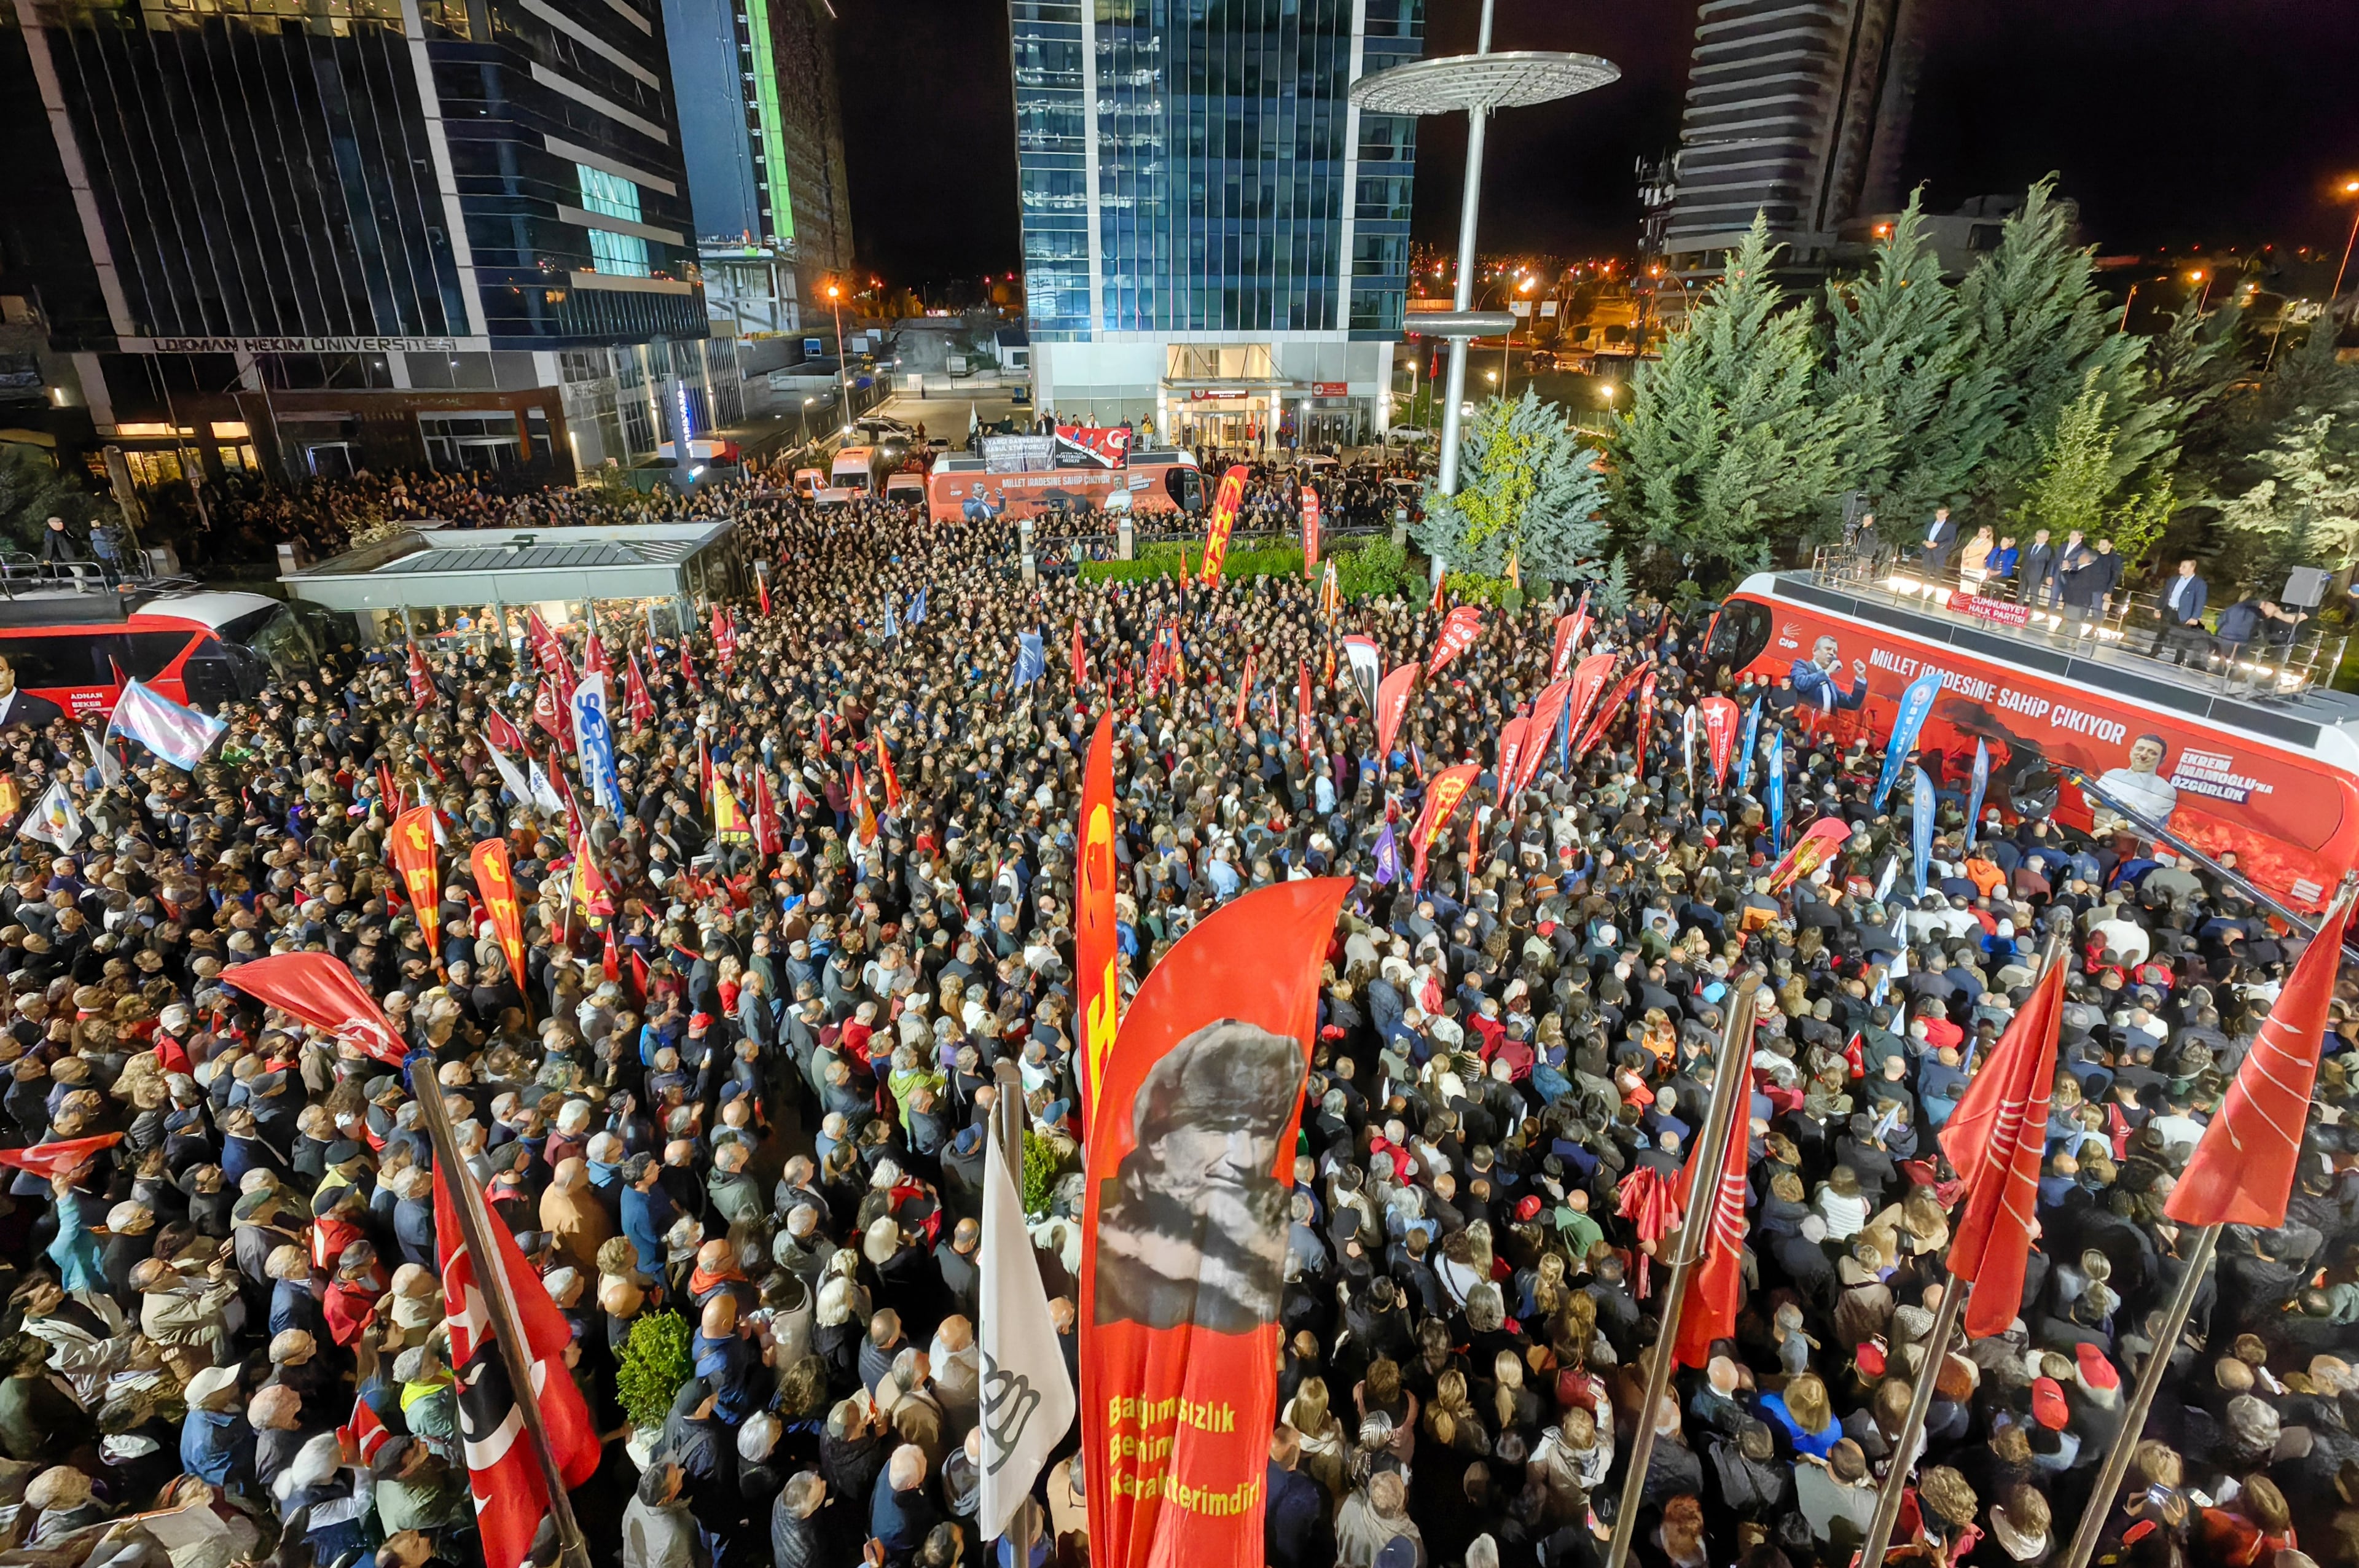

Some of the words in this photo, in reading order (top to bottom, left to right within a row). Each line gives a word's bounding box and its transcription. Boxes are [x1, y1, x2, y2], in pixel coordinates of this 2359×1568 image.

[153, 339, 238, 352] LOKMAN
[1968, 604, 1991, 615] HALK
[1778, 638, 1799, 650] CHP
[1869, 648, 1919, 677] MİLLET
[1997, 687, 2050, 719] SAHİP
[2050, 704, 2127, 746] ÇIKIYOR
[2180, 752, 2232, 772] EKREM
[720, 832, 751, 842] SEP
[1109, 1392, 1235, 1433] Bağımsızlık
[1109, 1432, 1173, 1467] Benim
